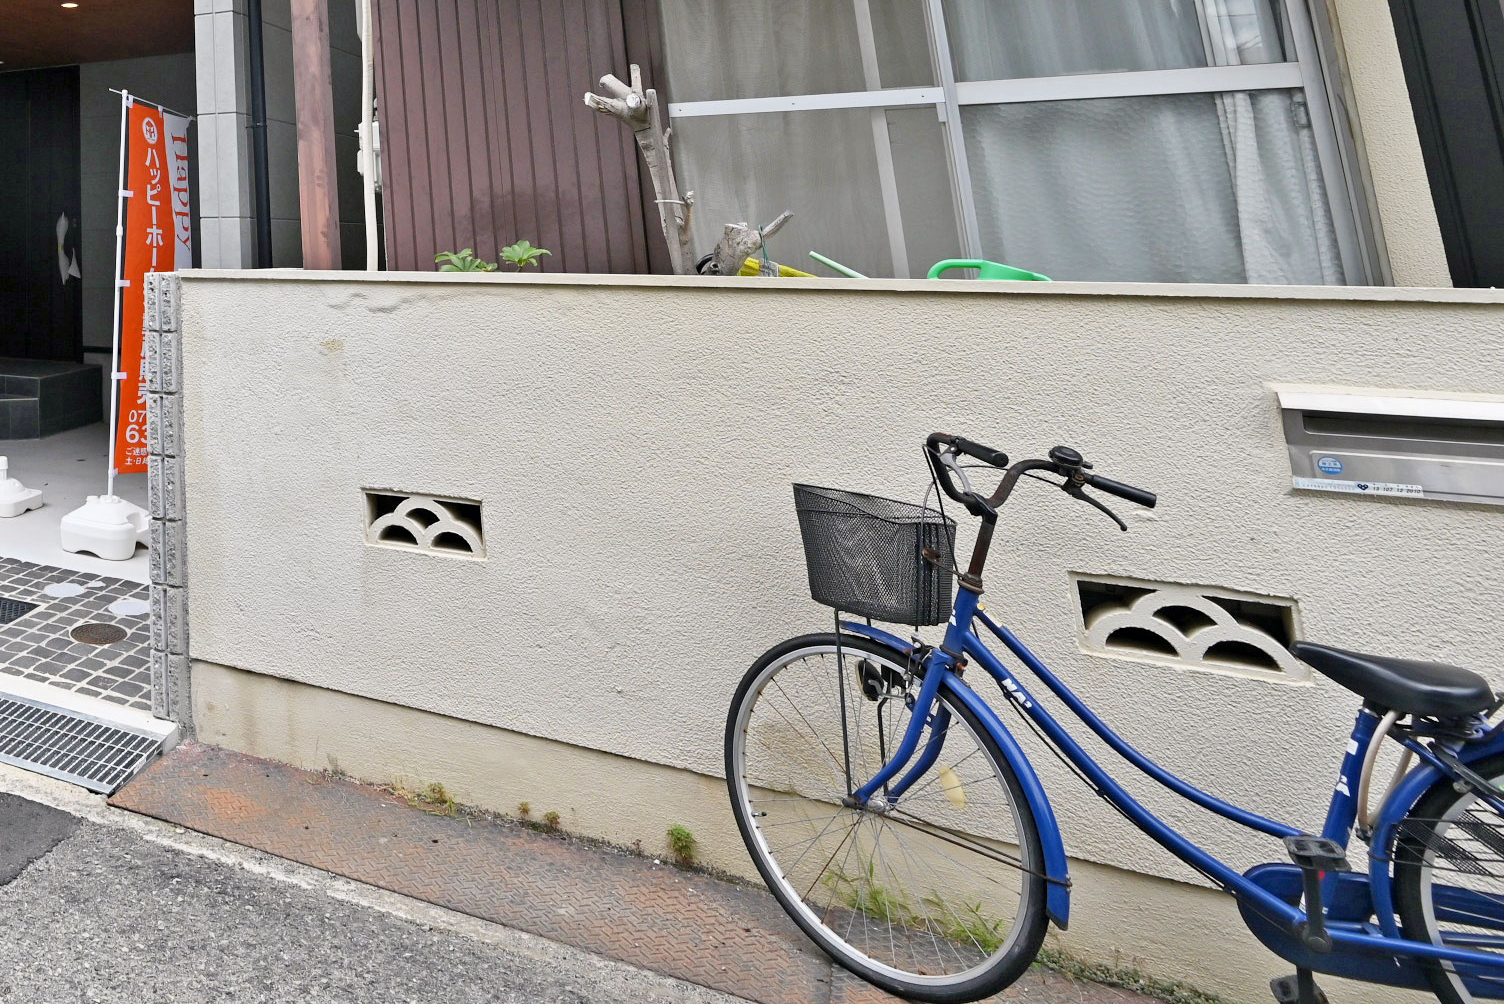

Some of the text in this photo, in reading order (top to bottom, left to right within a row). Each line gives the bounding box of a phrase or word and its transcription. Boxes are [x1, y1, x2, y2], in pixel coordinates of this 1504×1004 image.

[145, 147, 164, 273] ハッピーホー
